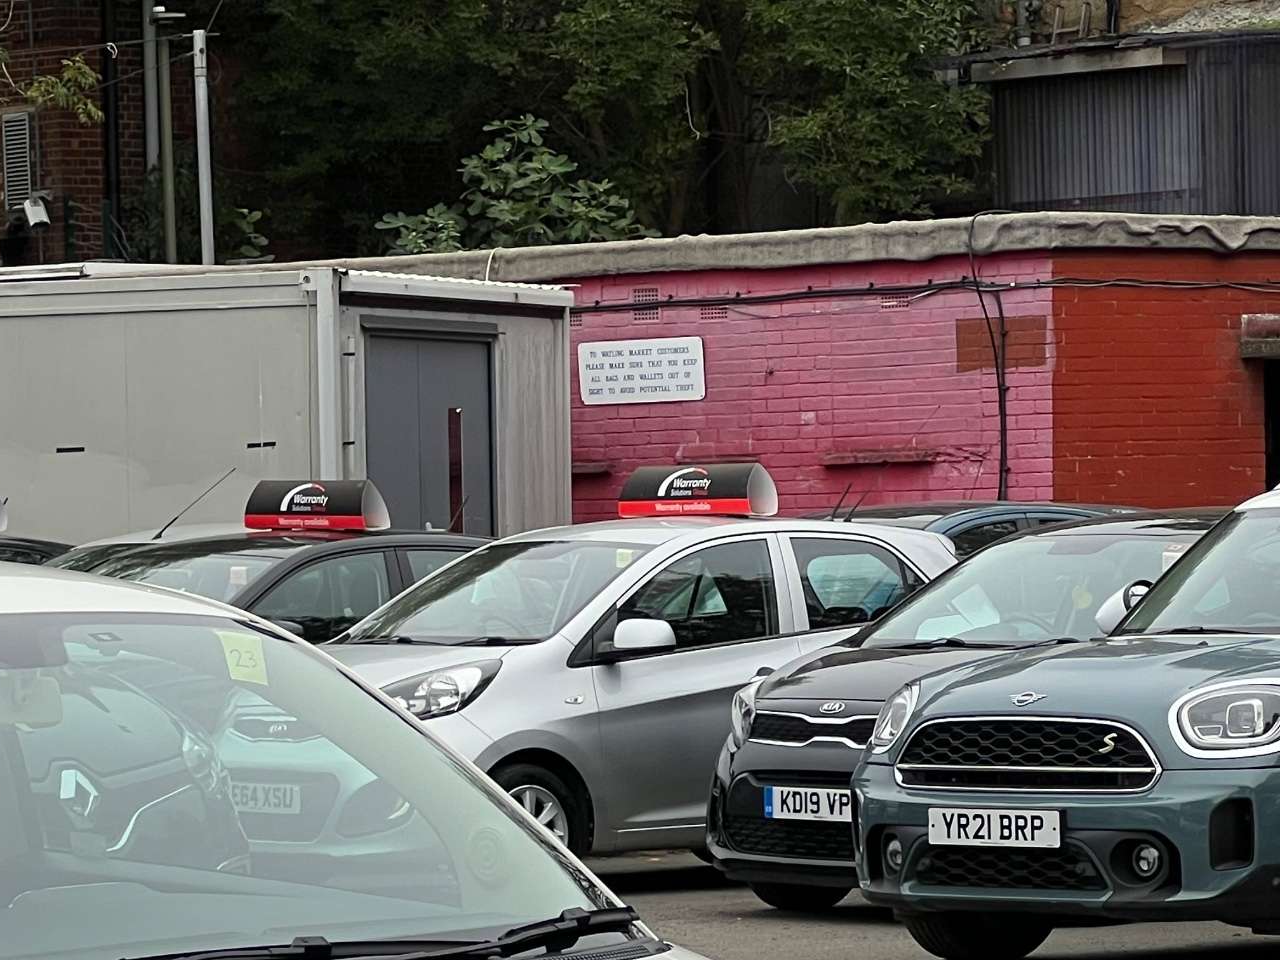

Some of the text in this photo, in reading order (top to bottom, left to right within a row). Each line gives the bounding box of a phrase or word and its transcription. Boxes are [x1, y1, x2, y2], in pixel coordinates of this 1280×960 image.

[629, 348, 653, 356] MARKET
[585, 362, 605, 370] PLEASE
[683, 358, 697, 366] KEEP
[639, 372, 664, 380] WALLETS
[639, 385, 671, 393] POTENTIAL
[672, 478, 712, 490] Warranty
[293, 494, 329, 507] Warranty
[229, 648, 258, 669] 23
[780, 790, 821, 814] KD19
[942, 812, 1044, 841] YR21 BRP
